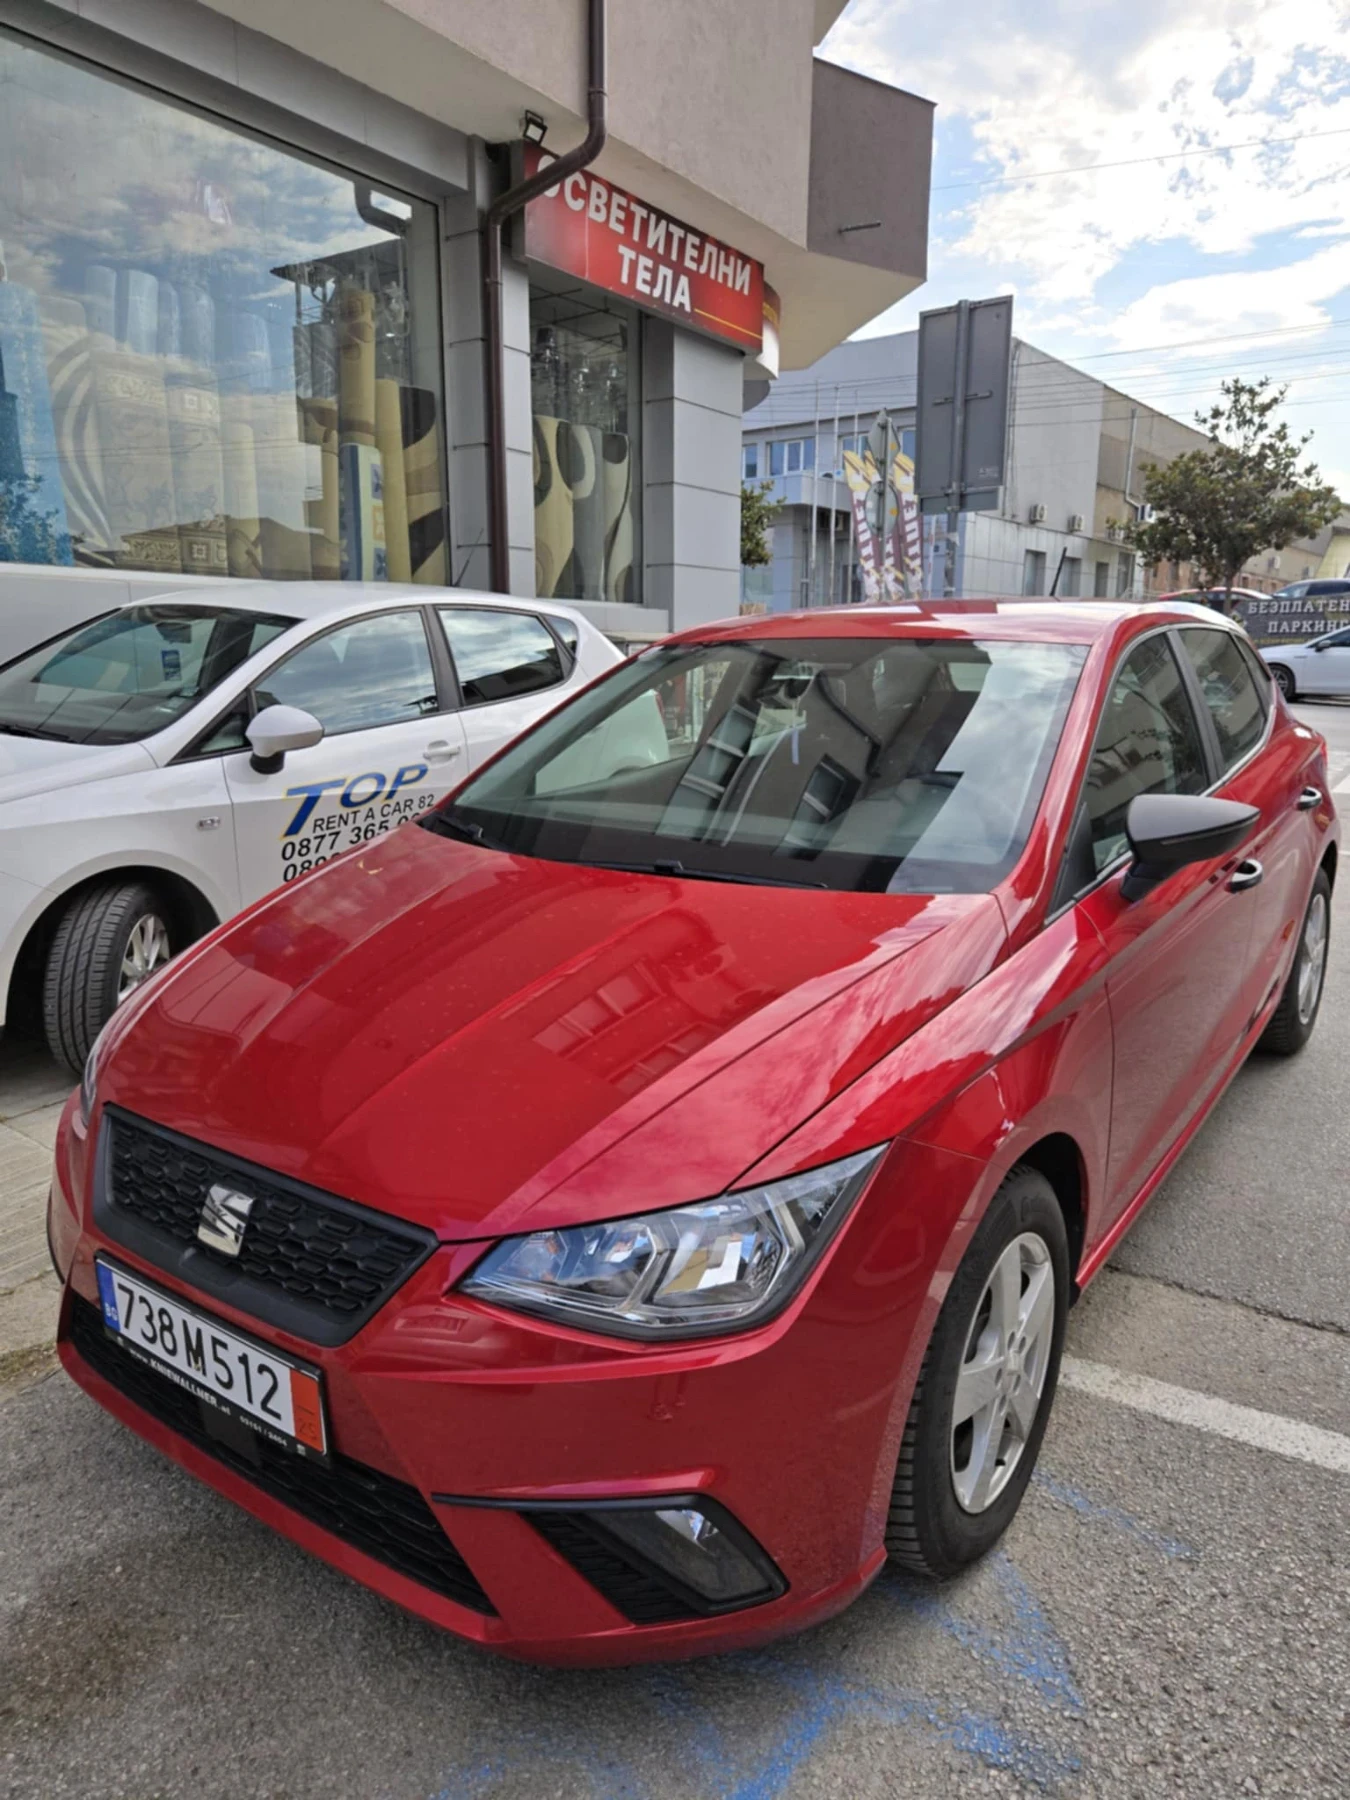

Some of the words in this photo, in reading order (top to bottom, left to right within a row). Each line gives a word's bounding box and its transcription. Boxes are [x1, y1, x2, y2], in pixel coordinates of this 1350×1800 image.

[617, 244, 692, 313] ТЕЛА
[1267, 619, 1349, 633] ПАРКИНГ
[281, 763, 430, 838] TOP
[312, 809, 360, 834] RENT
[364, 807, 375, 822] A
[380, 798, 414, 818] CAR
[418, 793, 435, 810] 82
[281, 831, 341, 861] 0877
[104, 1302, 118, 1321] BG
